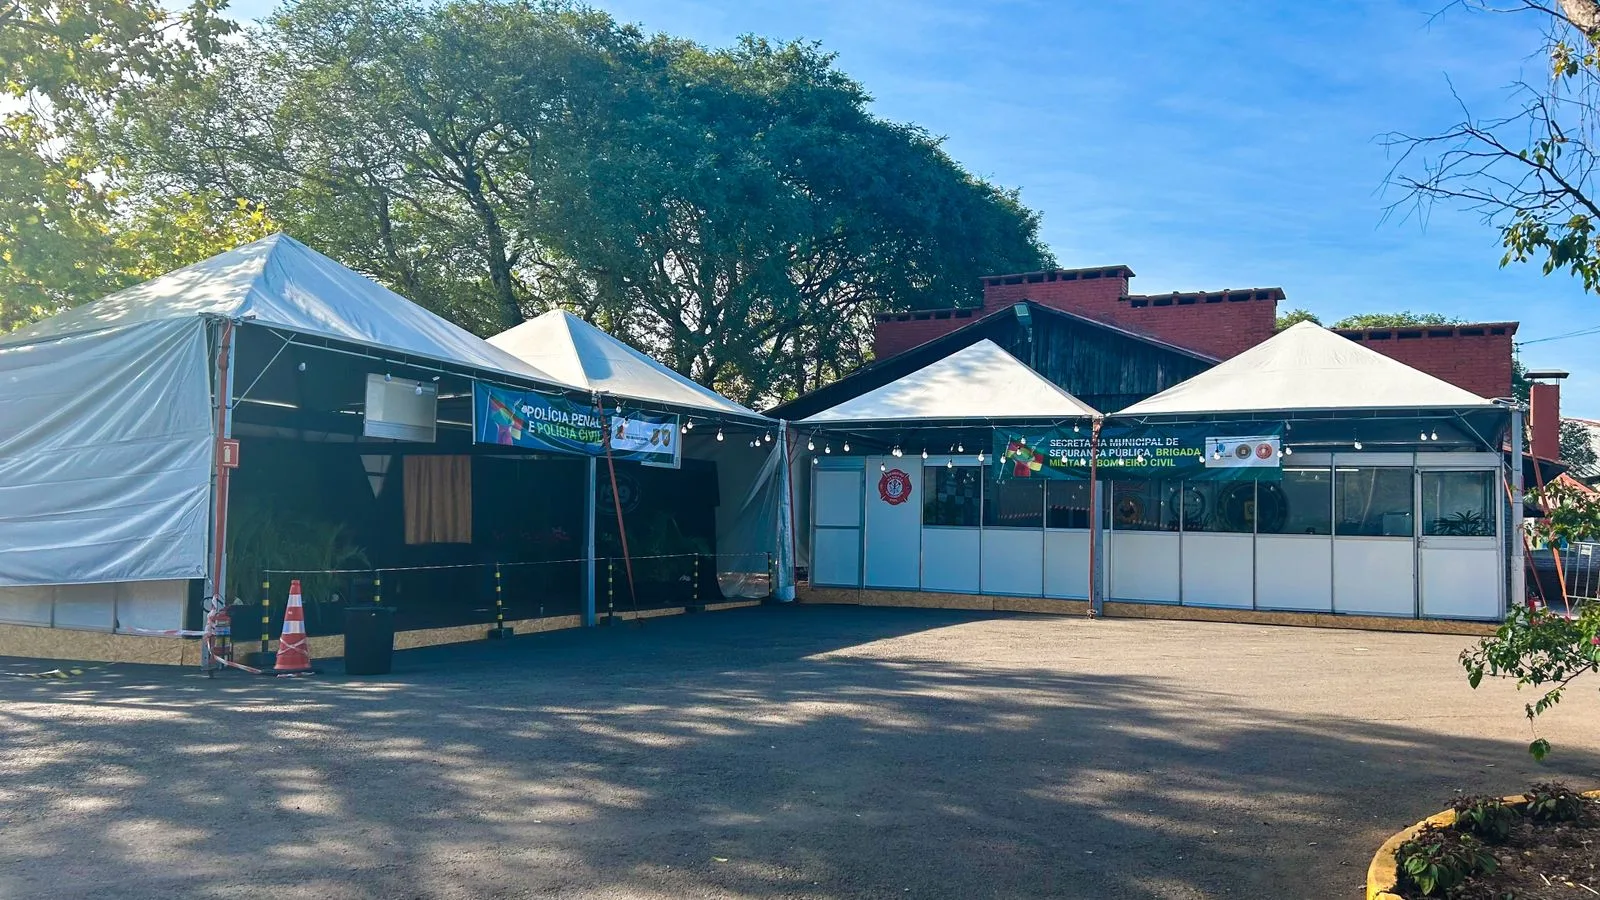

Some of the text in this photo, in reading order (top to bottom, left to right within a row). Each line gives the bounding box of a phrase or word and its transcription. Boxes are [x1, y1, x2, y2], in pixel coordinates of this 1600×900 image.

[526, 405, 602, 428] POLÍCIA PENAL
[528, 420, 604, 443] E POLÍCIA CIVIL
[1050, 437, 1179, 447] SECRETAIA MUNICIPAL DE
[1108, 447, 1153, 458] PÚBLICA,
[1155, 448, 1201, 457] BRIGADA
[1096, 458, 1148, 467] BOMEIRO
[1150, 458, 1176, 467] CIVIL
